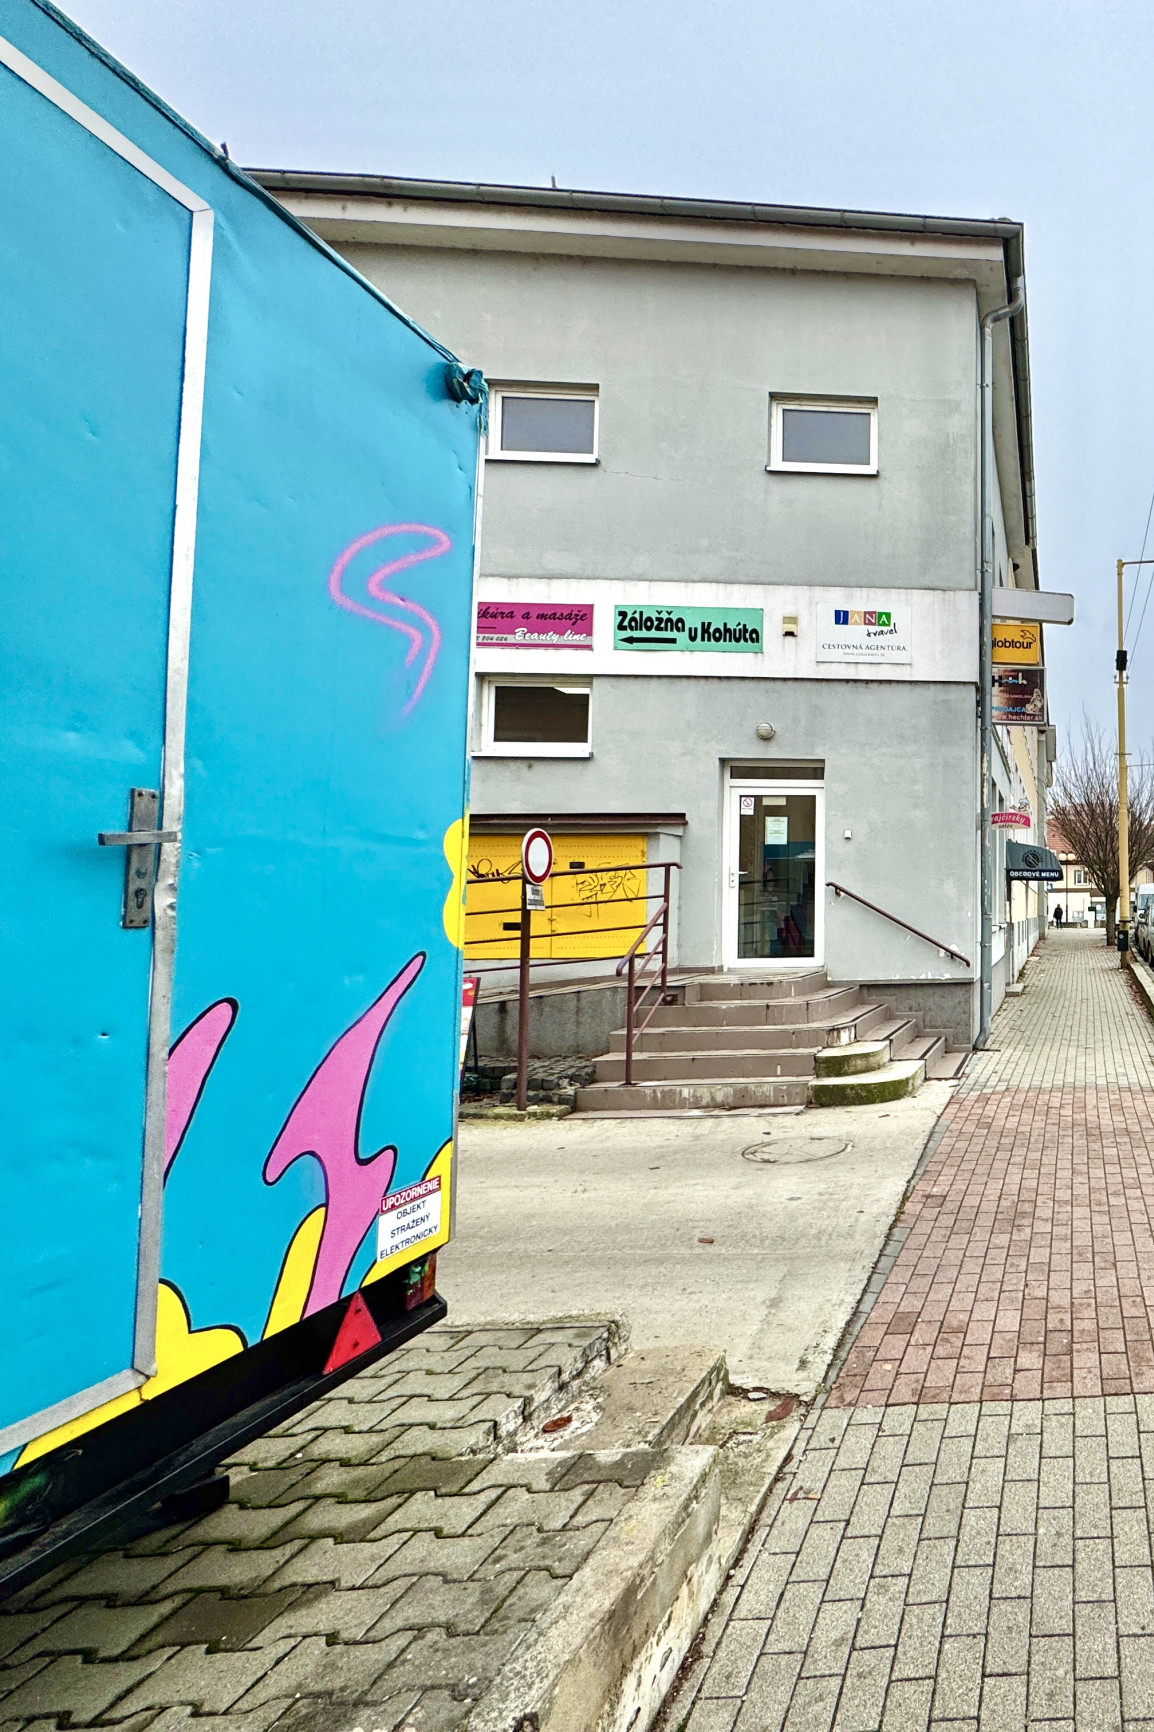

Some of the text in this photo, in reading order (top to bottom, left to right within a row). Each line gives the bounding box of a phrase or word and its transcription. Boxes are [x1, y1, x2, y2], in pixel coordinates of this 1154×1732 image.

[521, 611, 532, 620] a
[536, 609, 588, 626] masáže
[616, 609, 686, 633] Záložňa
[836, 611, 890, 625] JANA
[514, 627, 587, 643] Beauty line
[688, 621, 760, 644] u Kohúta
[866, 622, 898, 638] travel
[821, 642, 907, 652] CESTOVNÁ AGENTÚRA
[991, 637, 1034, 650] lobtour
[1009, 870, 1040, 878] OBEDOVÉ
[382, 1177, 440, 1211] UPOZORNENIE
[396, 1200, 427, 1220] OBJEKT
[380, 1223, 439, 1259] ELEKTRONICKY
